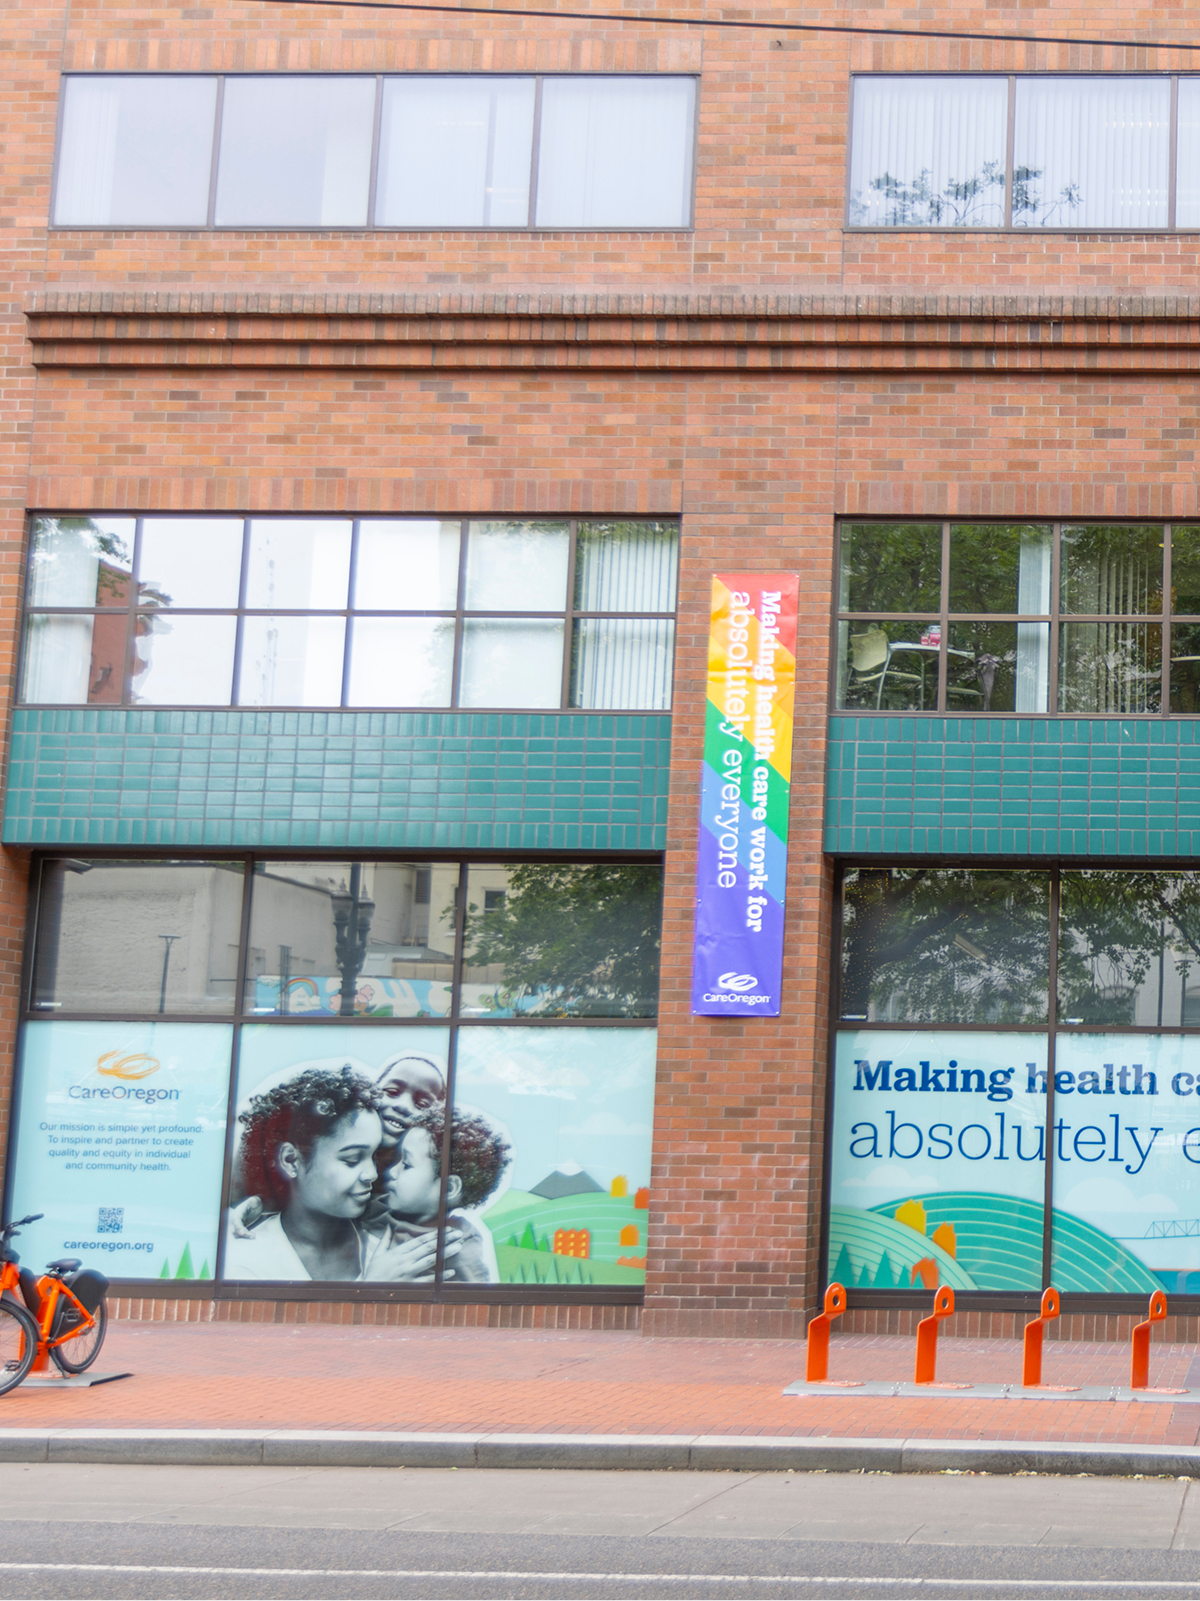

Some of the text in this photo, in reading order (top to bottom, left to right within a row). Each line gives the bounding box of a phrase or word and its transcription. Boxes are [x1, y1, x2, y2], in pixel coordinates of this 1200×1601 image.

[714, 591, 755, 888] absolutely everyone
[746, 591, 782, 932] Making health care work for
[703, 993, 770, 1005] CareOregon
[853, 1060, 1015, 1102] Making
[1025, 1062, 1159, 1095] health
[68, 1085, 181, 1104] CareOregon
[40, 1122, 204, 1136] Our mission is simple yet profound:
[48, 1135, 194, 1148] To inspire and partner to create
[849, 1110, 1164, 1175] absolutely
[48, 1148, 191, 1160] quality and equity in individual
[65, 1161, 172, 1173] and community health.
[64, 1240, 154, 1252] careoregon.org
